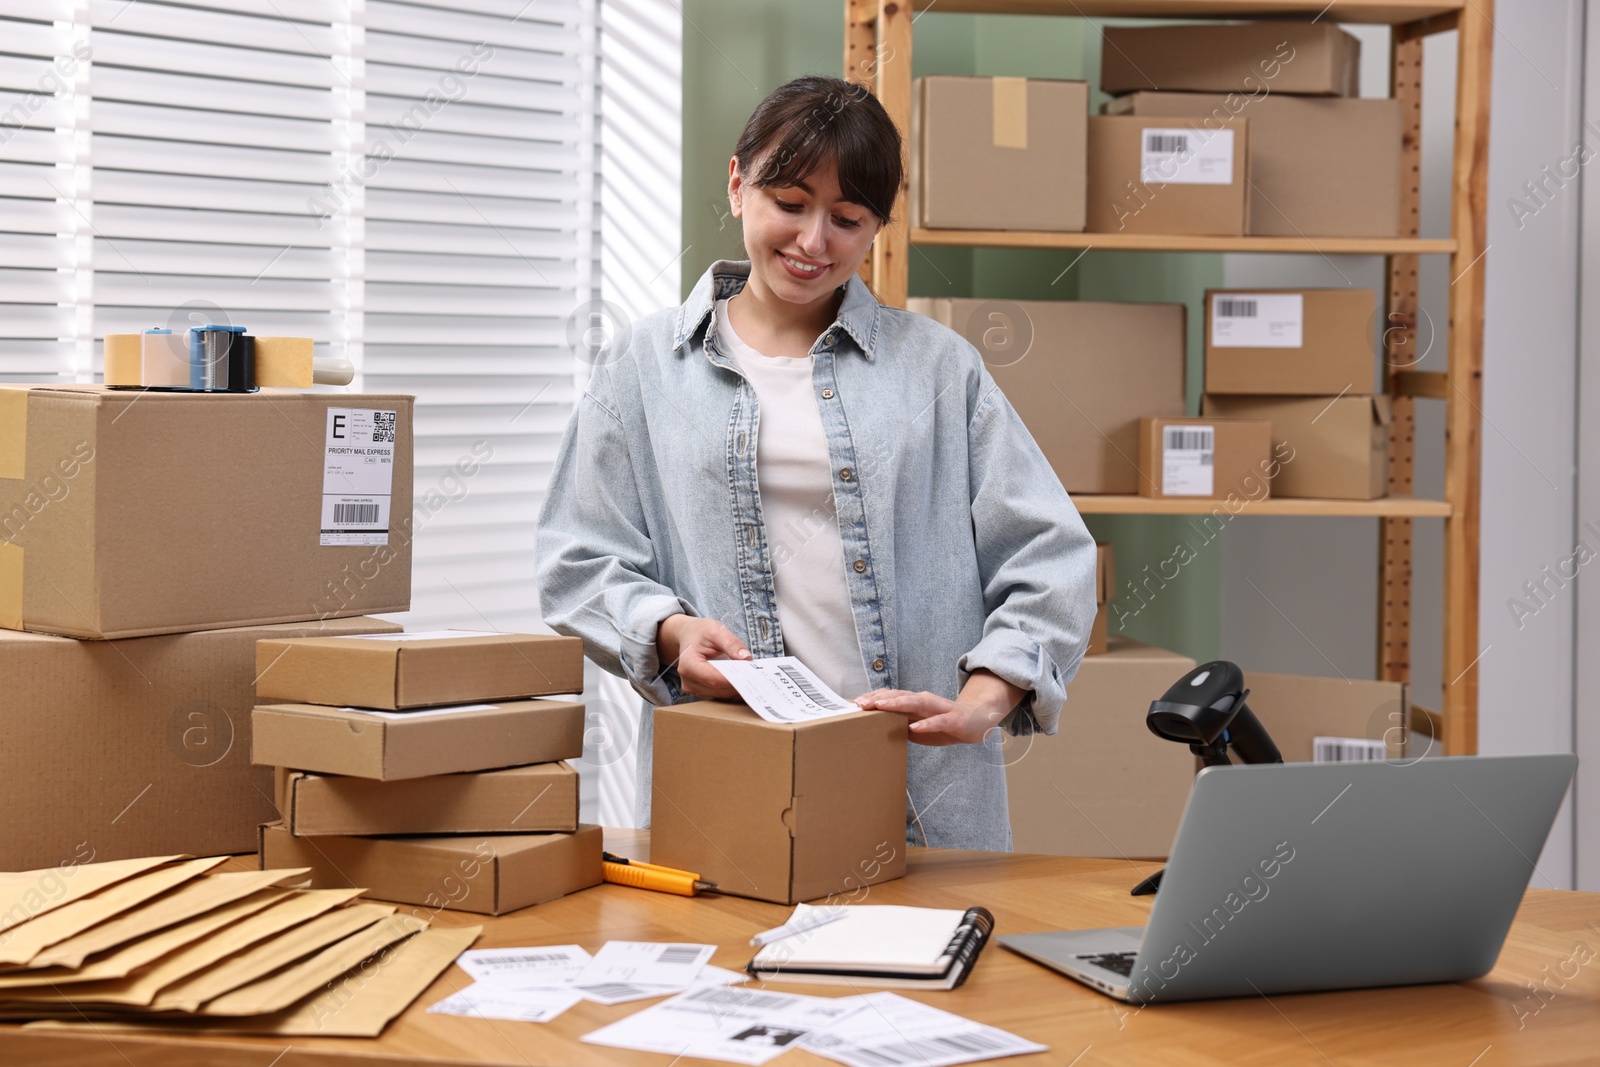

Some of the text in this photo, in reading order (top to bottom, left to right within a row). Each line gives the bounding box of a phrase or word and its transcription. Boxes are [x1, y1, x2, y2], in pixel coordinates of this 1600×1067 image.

[333, 415, 346, 439] E
[328, 447, 353, 455] PRIORITY
[366, 448, 391, 456] EXPRESS
